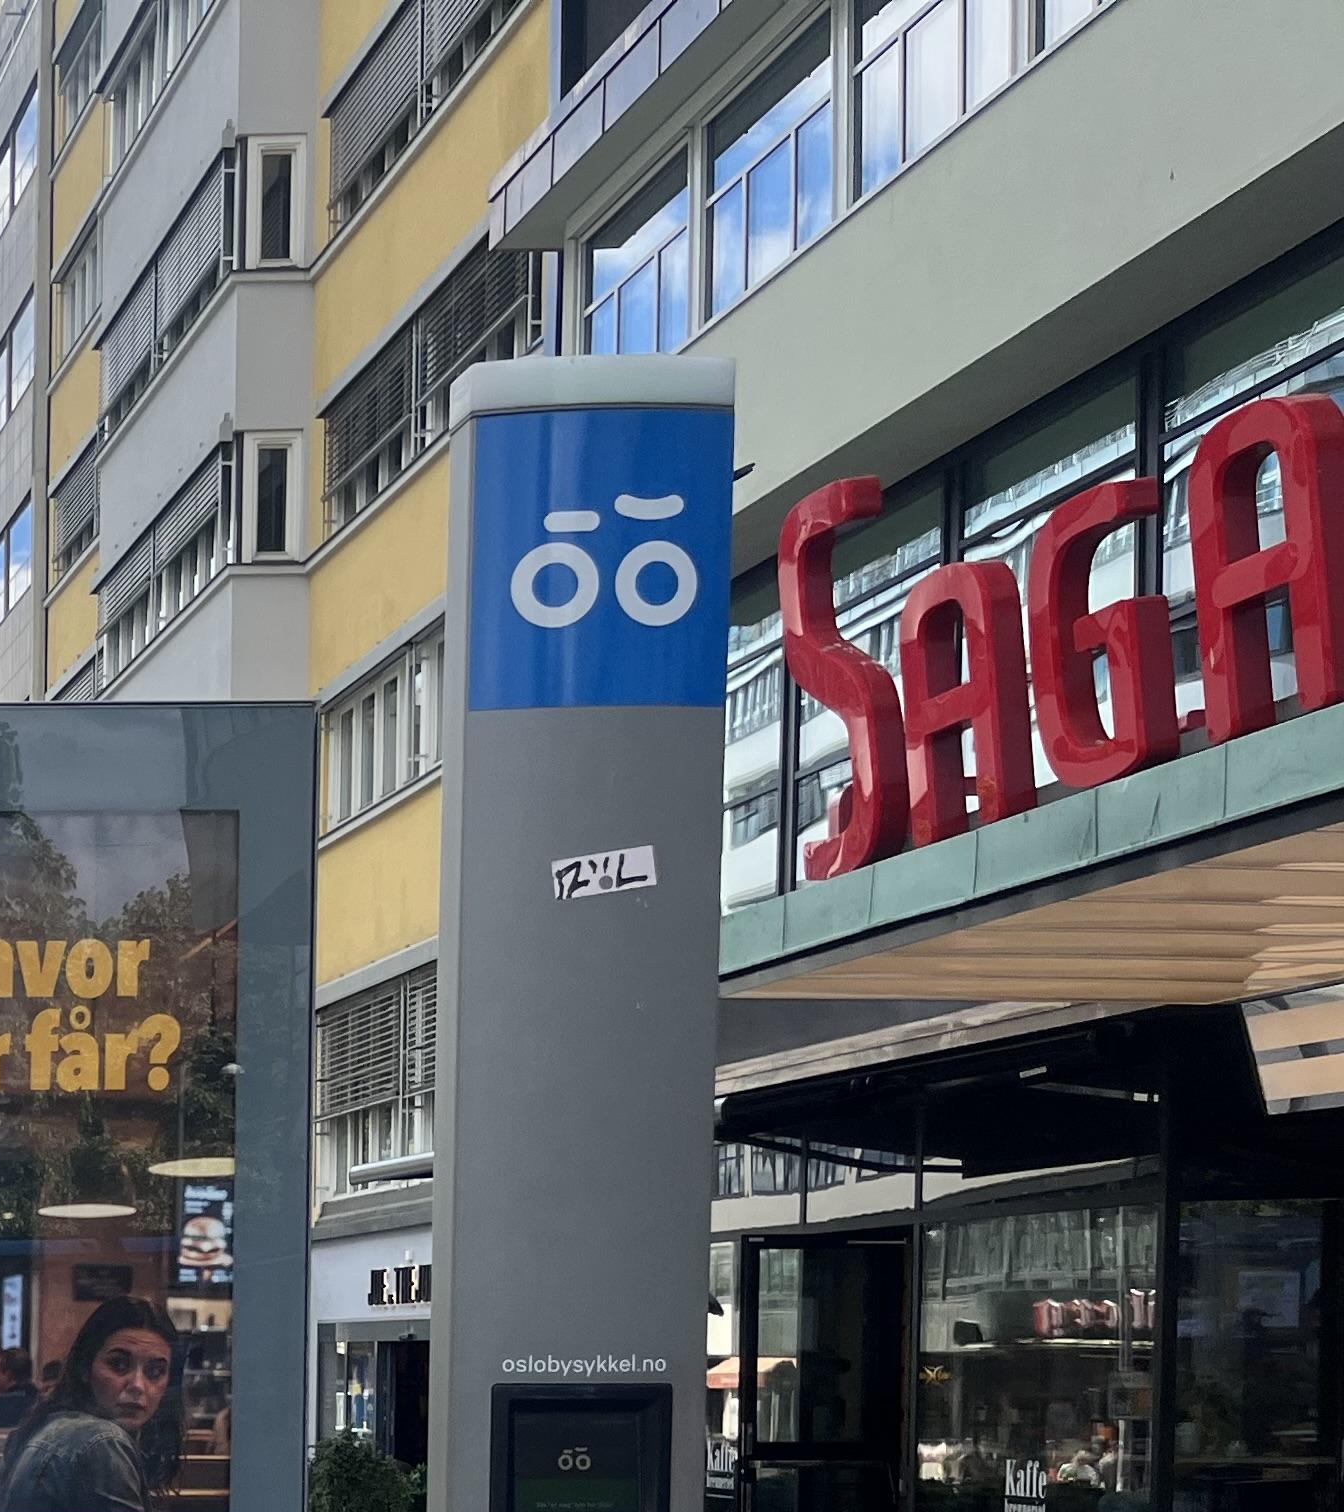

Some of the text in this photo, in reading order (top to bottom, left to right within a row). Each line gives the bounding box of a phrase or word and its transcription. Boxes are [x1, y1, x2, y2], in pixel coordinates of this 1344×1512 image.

[778, 393, 1344, 881] SAGA
[24, 1004, 182, 1092] får?
[502, 1354, 667, 1377] oslobysykkel.no
[1004, 1458, 1048, 1499] Kaffe
